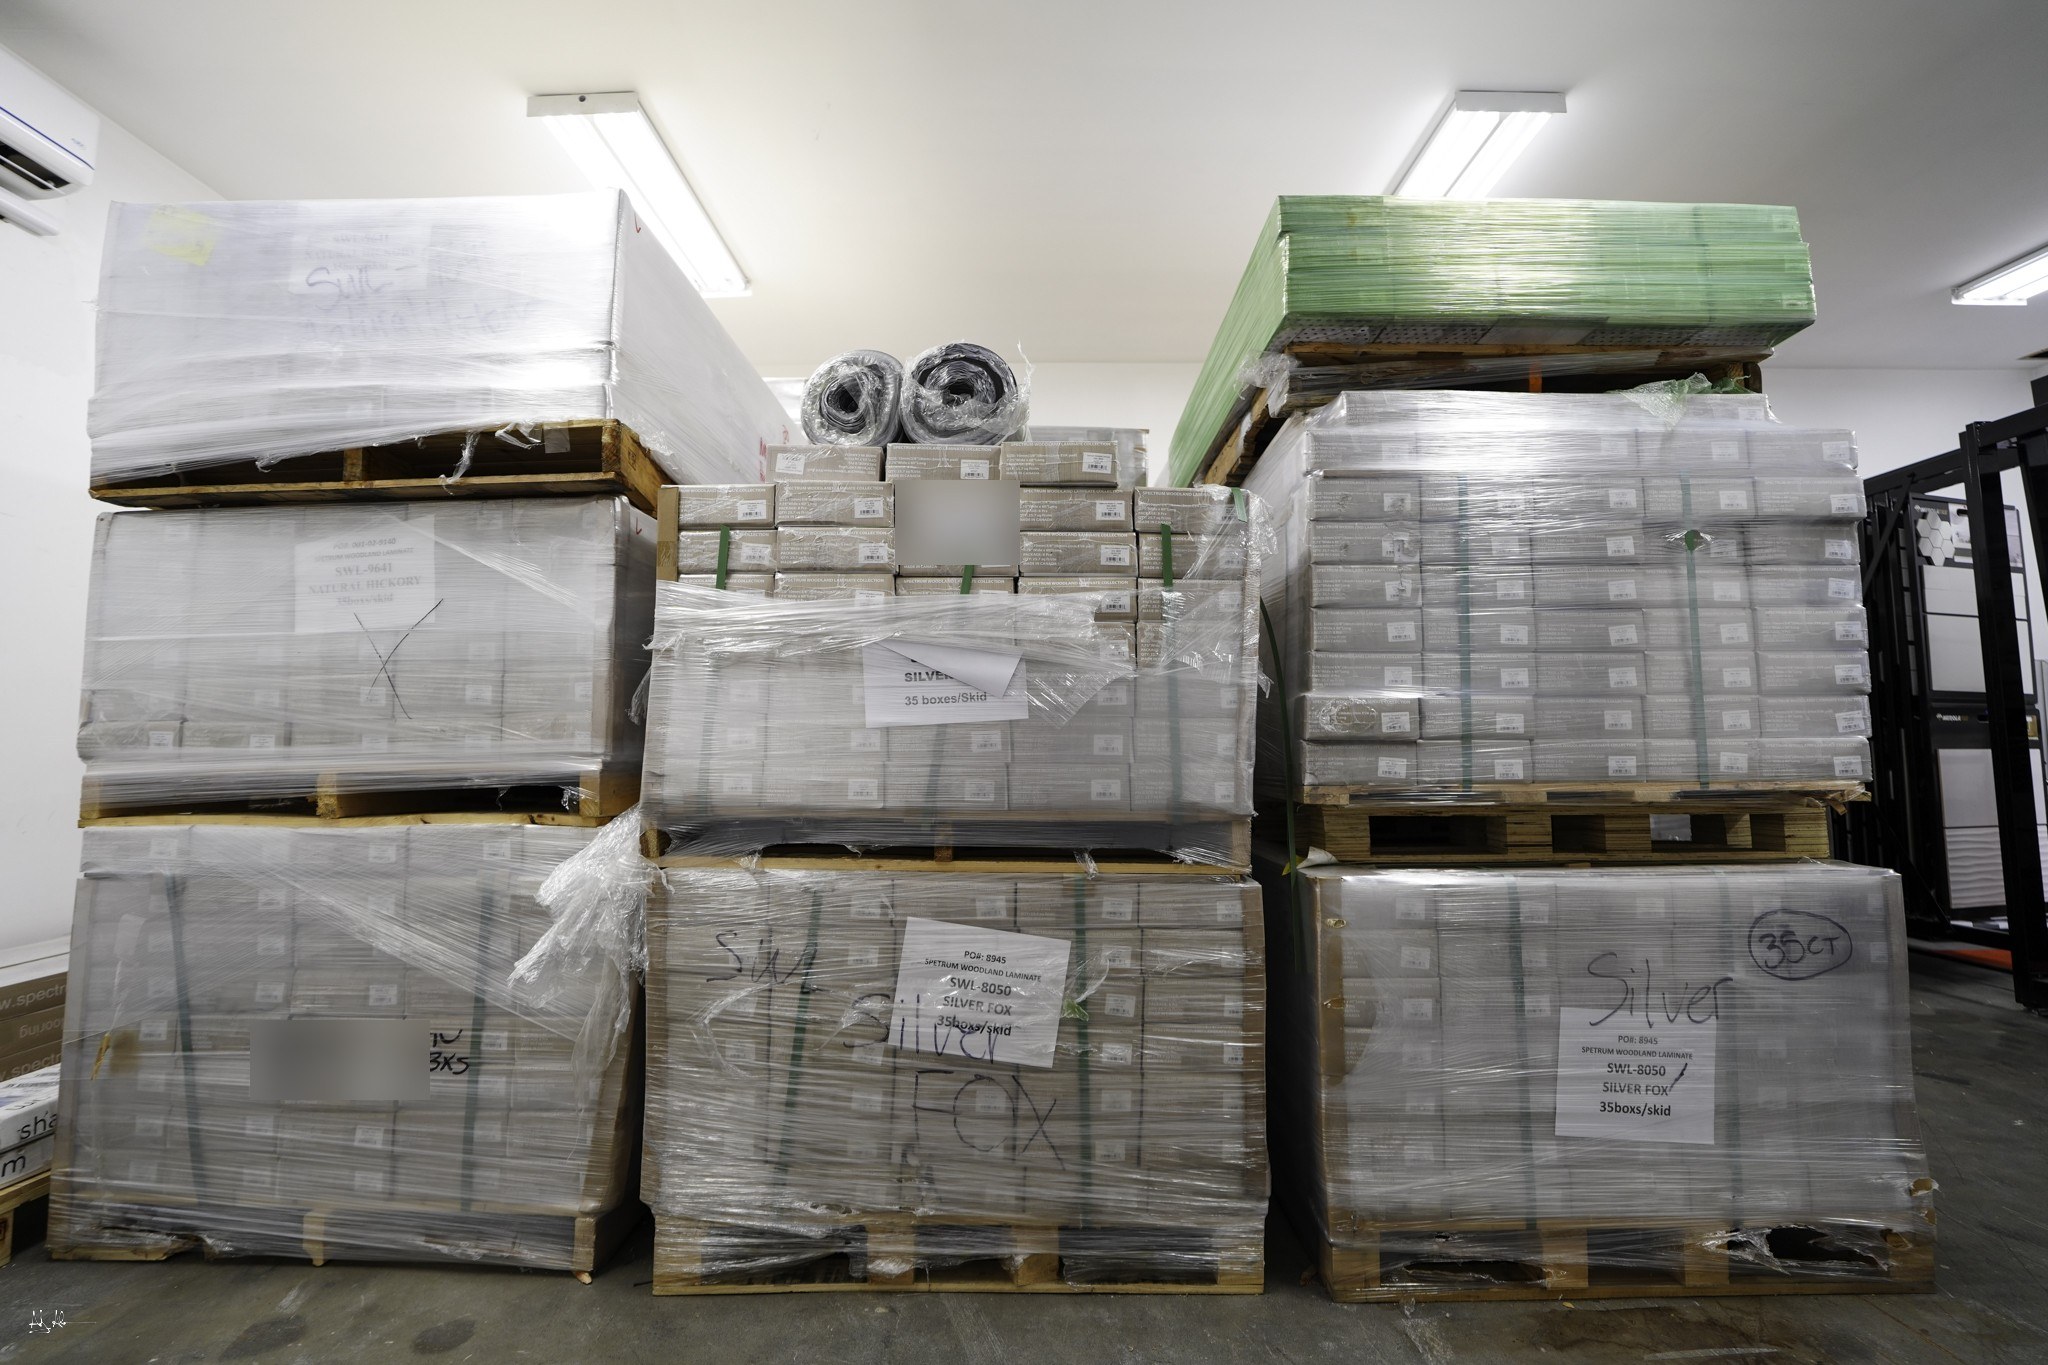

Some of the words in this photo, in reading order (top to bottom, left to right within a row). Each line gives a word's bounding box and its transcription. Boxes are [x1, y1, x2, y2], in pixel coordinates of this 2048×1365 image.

[335, 562, 392, 577] SWL-9641
[308, 581, 361, 594] NATURAL
[366, 575, 421, 590] HICKORY
[904, 670, 954, 683] SILVE
[904, 695, 919, 706] 35
[922, 692, 988, 705] boxes/Skid
[964, 950, 984, 962] PO#:
[985, 953, 1007, 964] 8945
[924, 958, 959, 970] SPETRUM
[960, 963, 1004, 977] WOODLAND
[1005, 971, 1042, 983] LAMINATE
[949, 976, 1012, 997] SWL-8050
[1587, 952, 1734, 1029] Silver
[942, 995, 985, 1013] SILVER
[987, 1002, 1012, 1016] FOX
[936, 1013, 1012, 1037] 35boxs/skid
[1618, 1035, 1637, 1044] PO#:
[1638, 1035, 1658, 1045] 8945
[1581, 1046, 1615, 1055] SPETRUM
[1616, 1048, 1657, 1058] WOODLAND
[1658, 1051, 1693, 1060] LAMINATE
[1606, 1062, 1666, 1077] SWL-8050
[1602, 1081, 1642, 1095] SILVER
[1645, 1084, 1669, 1096] FOX
[1599, 1101, 1671, 1117] 35boxs/skid
[912, 1070, 1066, 1172] FOX
